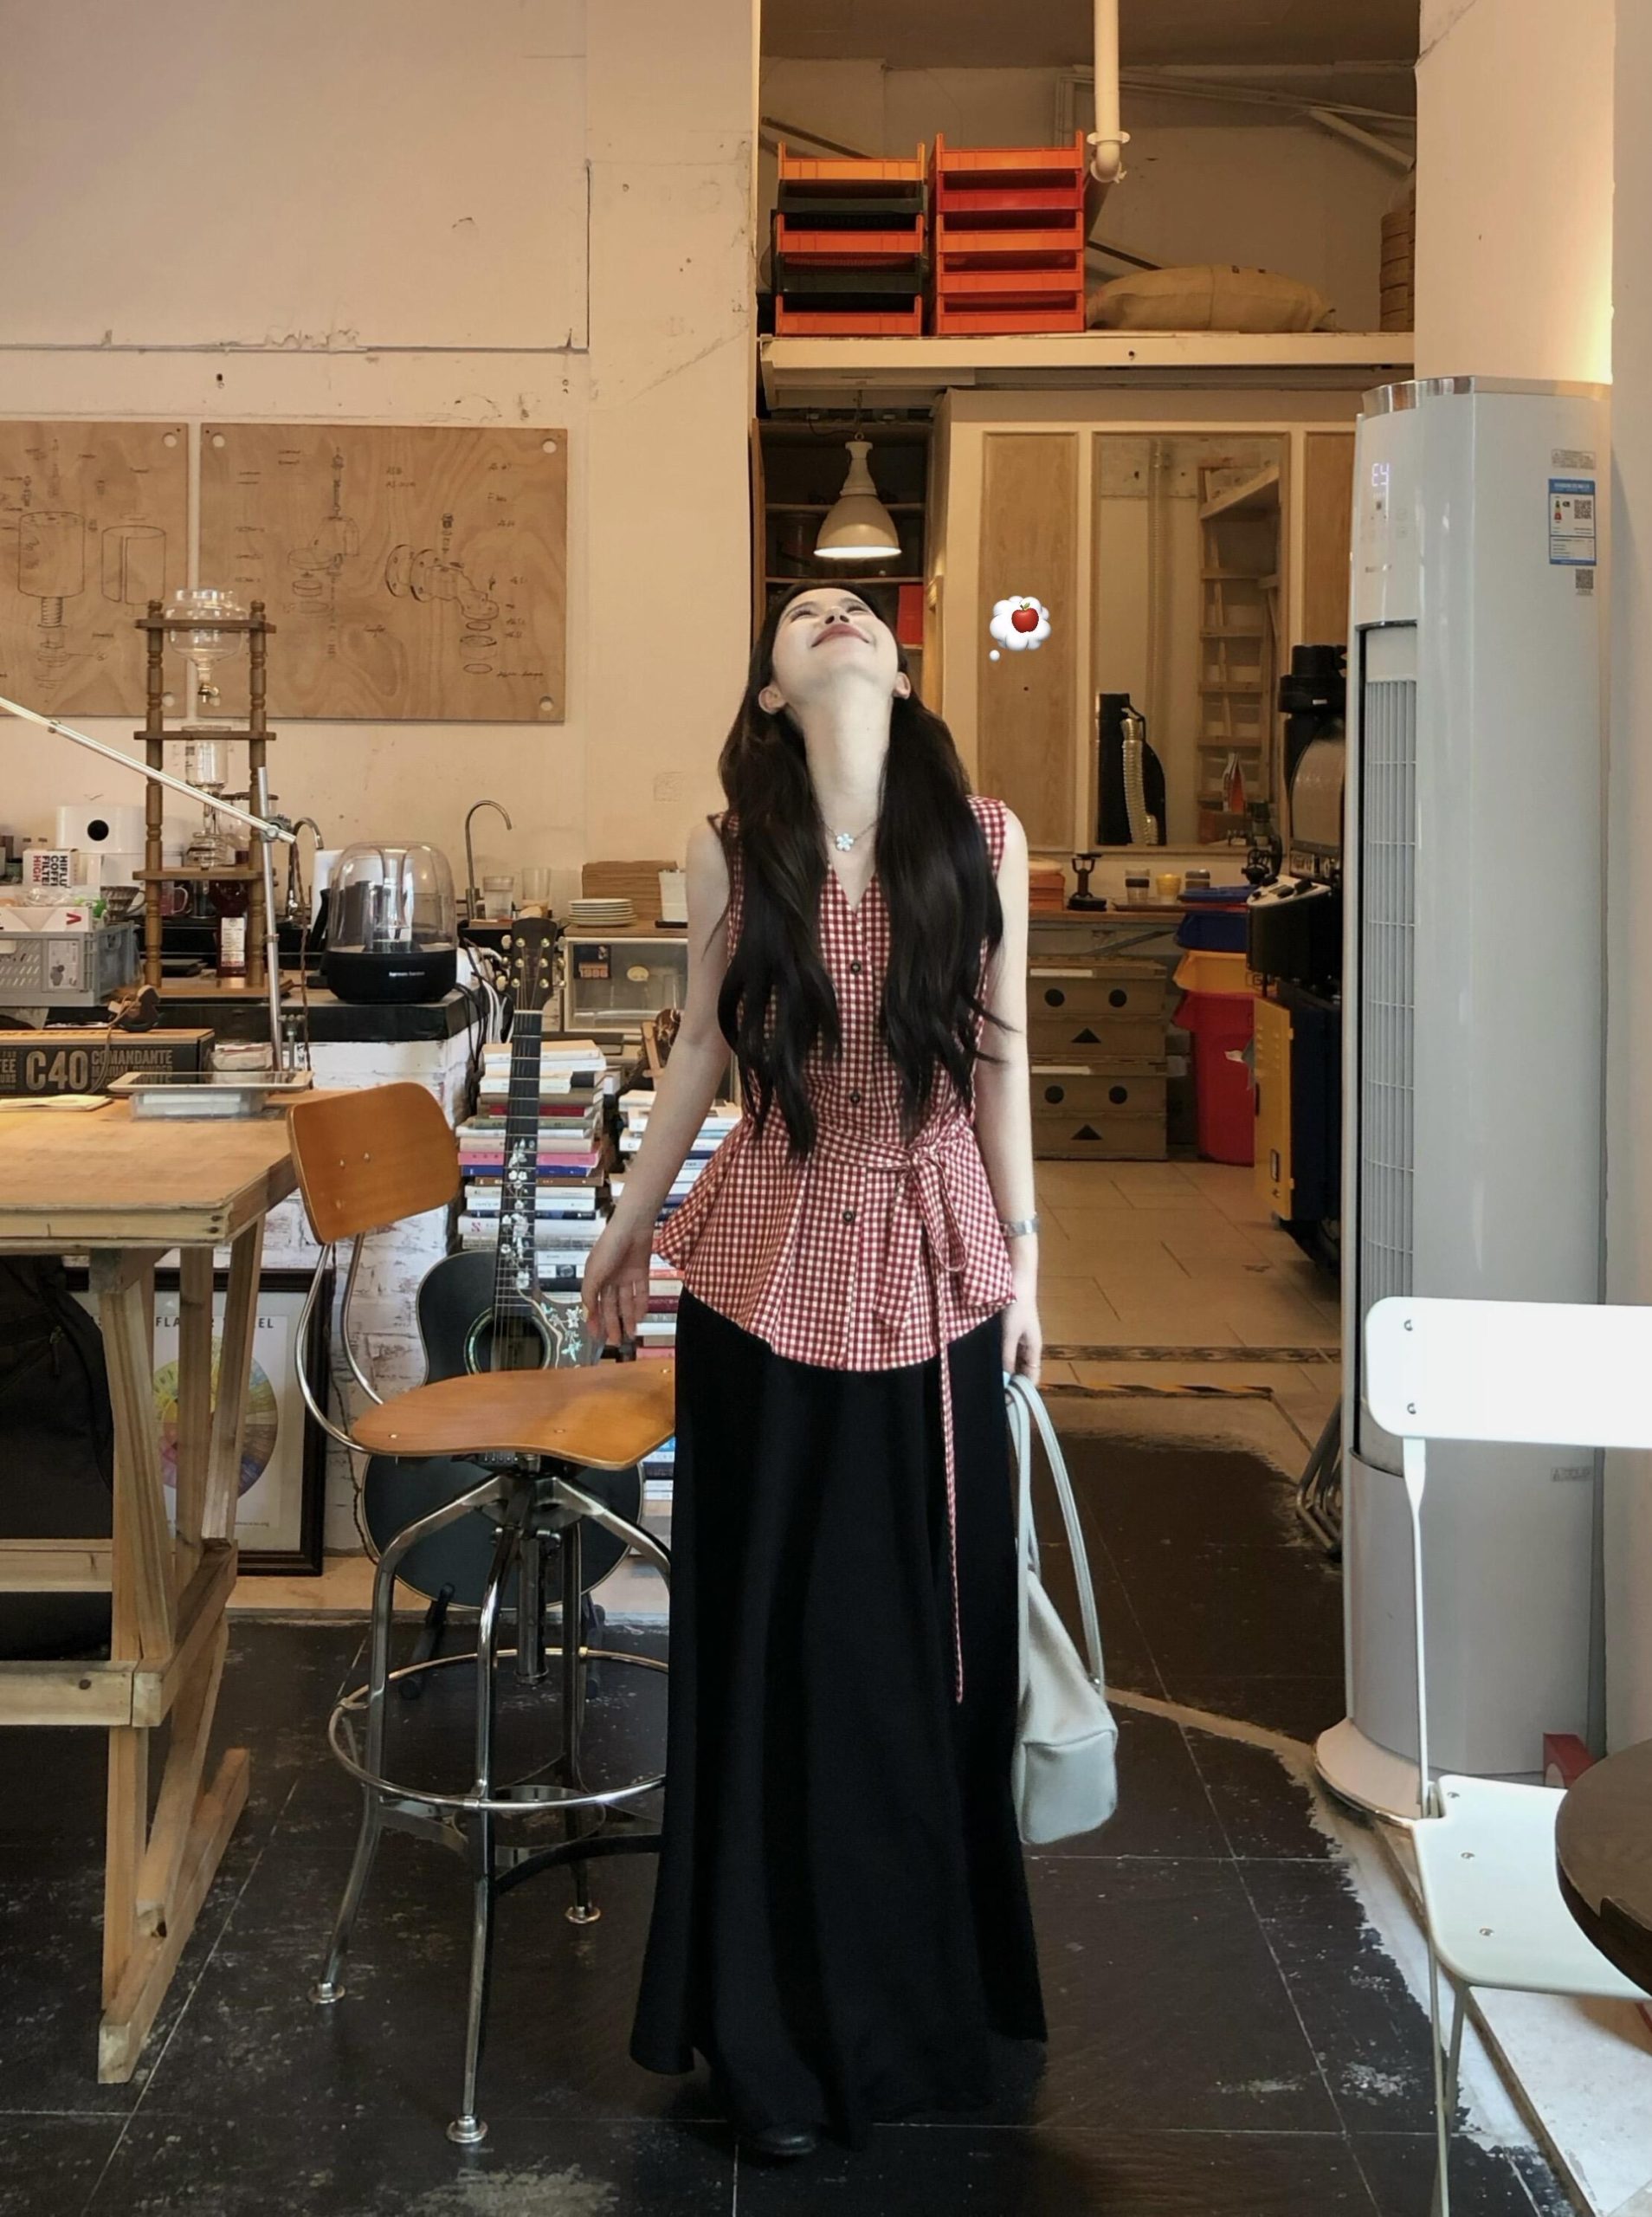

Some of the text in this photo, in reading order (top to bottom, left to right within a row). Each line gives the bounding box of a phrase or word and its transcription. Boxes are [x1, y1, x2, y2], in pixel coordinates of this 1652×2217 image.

[33, 855, 42, 882] HIGH
[59, 855, 68, 887] HIFLU
[26, 1050, 87, 1090] C40
